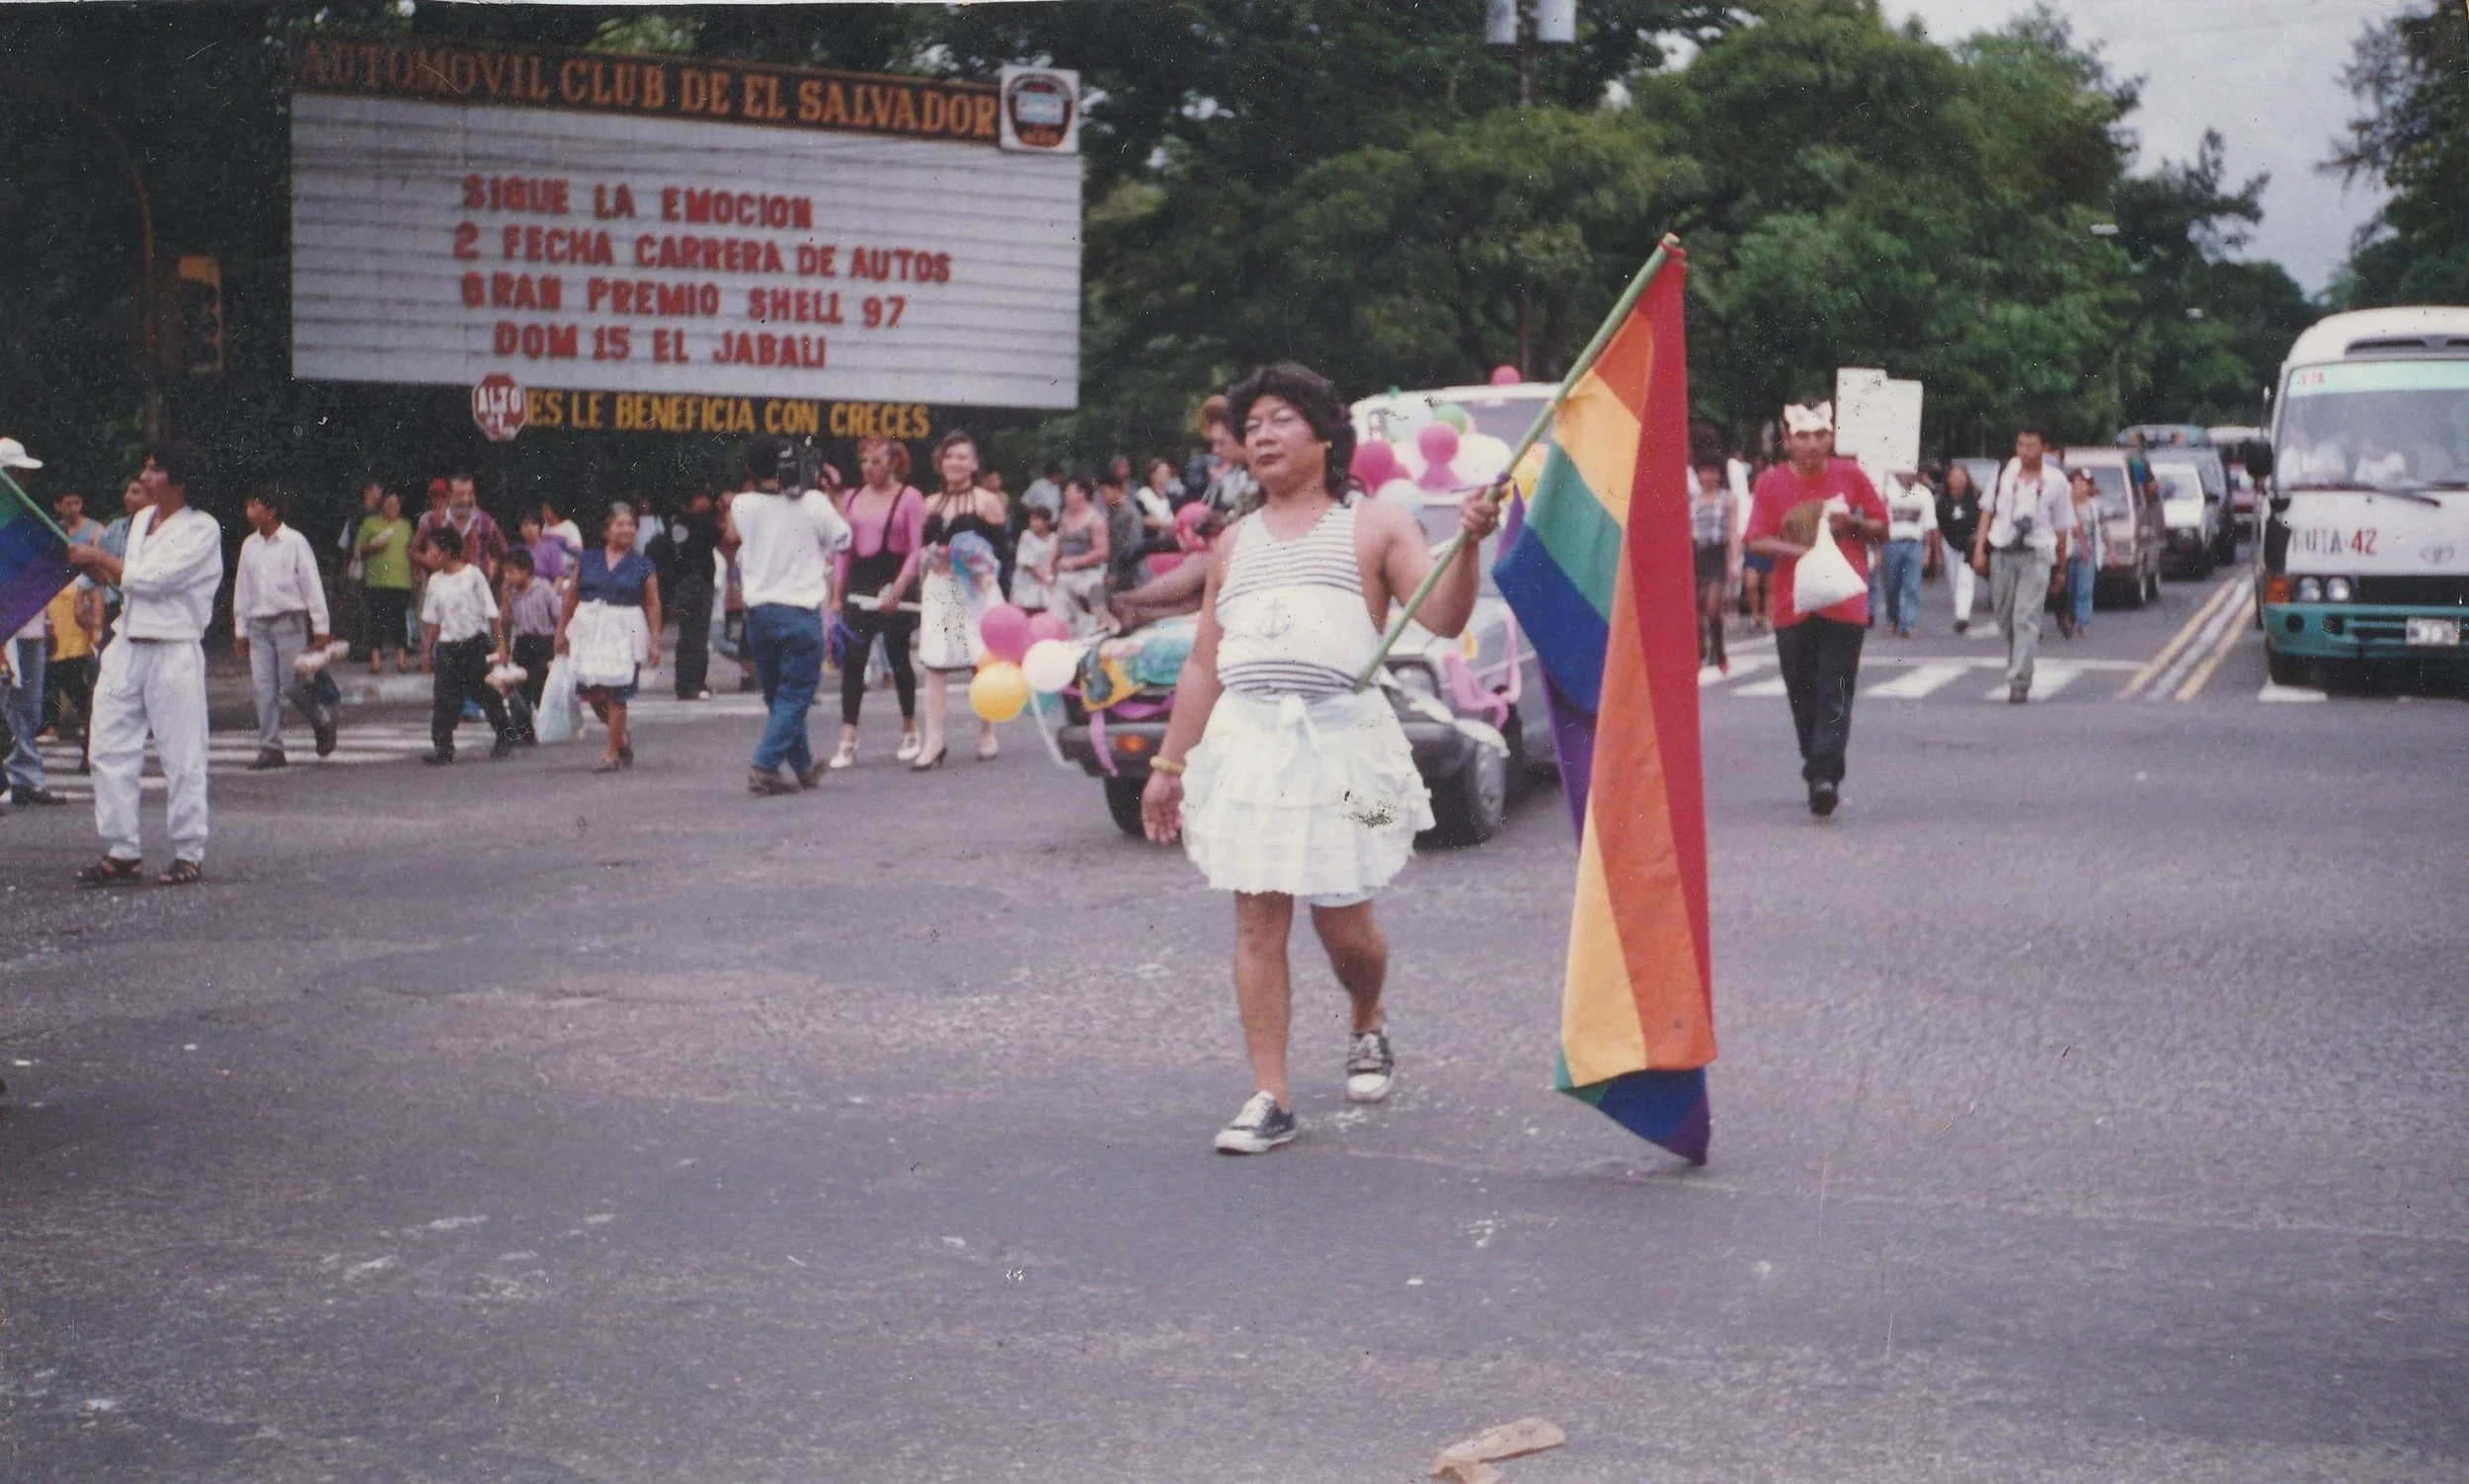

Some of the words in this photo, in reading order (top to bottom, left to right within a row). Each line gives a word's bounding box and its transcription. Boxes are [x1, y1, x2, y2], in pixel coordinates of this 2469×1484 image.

[301, 38, 550, 99] AUTOMOVIL
[560, 57, 666, 110] CLUB
[680, 67, 730, 116] DE
[744, 74, 787, 119] EL
[798, 78, 996, 137] SALVADOR
[462, 173, 570, 215] SIGUE
[595, 182, 635, 220] LA
[662, 186, 813, 230] EMOCION
[453, 221, 481, 261] 2
[503, 223, 614, 266] FECHA
[635, 232, 784, 273] CARRERA
[797, 243, 836, 277] DE
[848, 245, 951, 283] AUTOS
[588, 275, 720, 317] PREMIO
[748, 286, 844, 324] SHELL
[861, 294, 907, 329] 97
[494, 320, 578, 360] DOM
[594, 325, 632, 361] 15
[653, 328, 689, 364] EL
[478, 386, 521, 415] ALTO
[571, 391, 604, 429] LE
[615, 391, 756, 434] BENEFICIA
[764, 396, 819, 434] CON
[830, 400, 931, 438] CRECES
